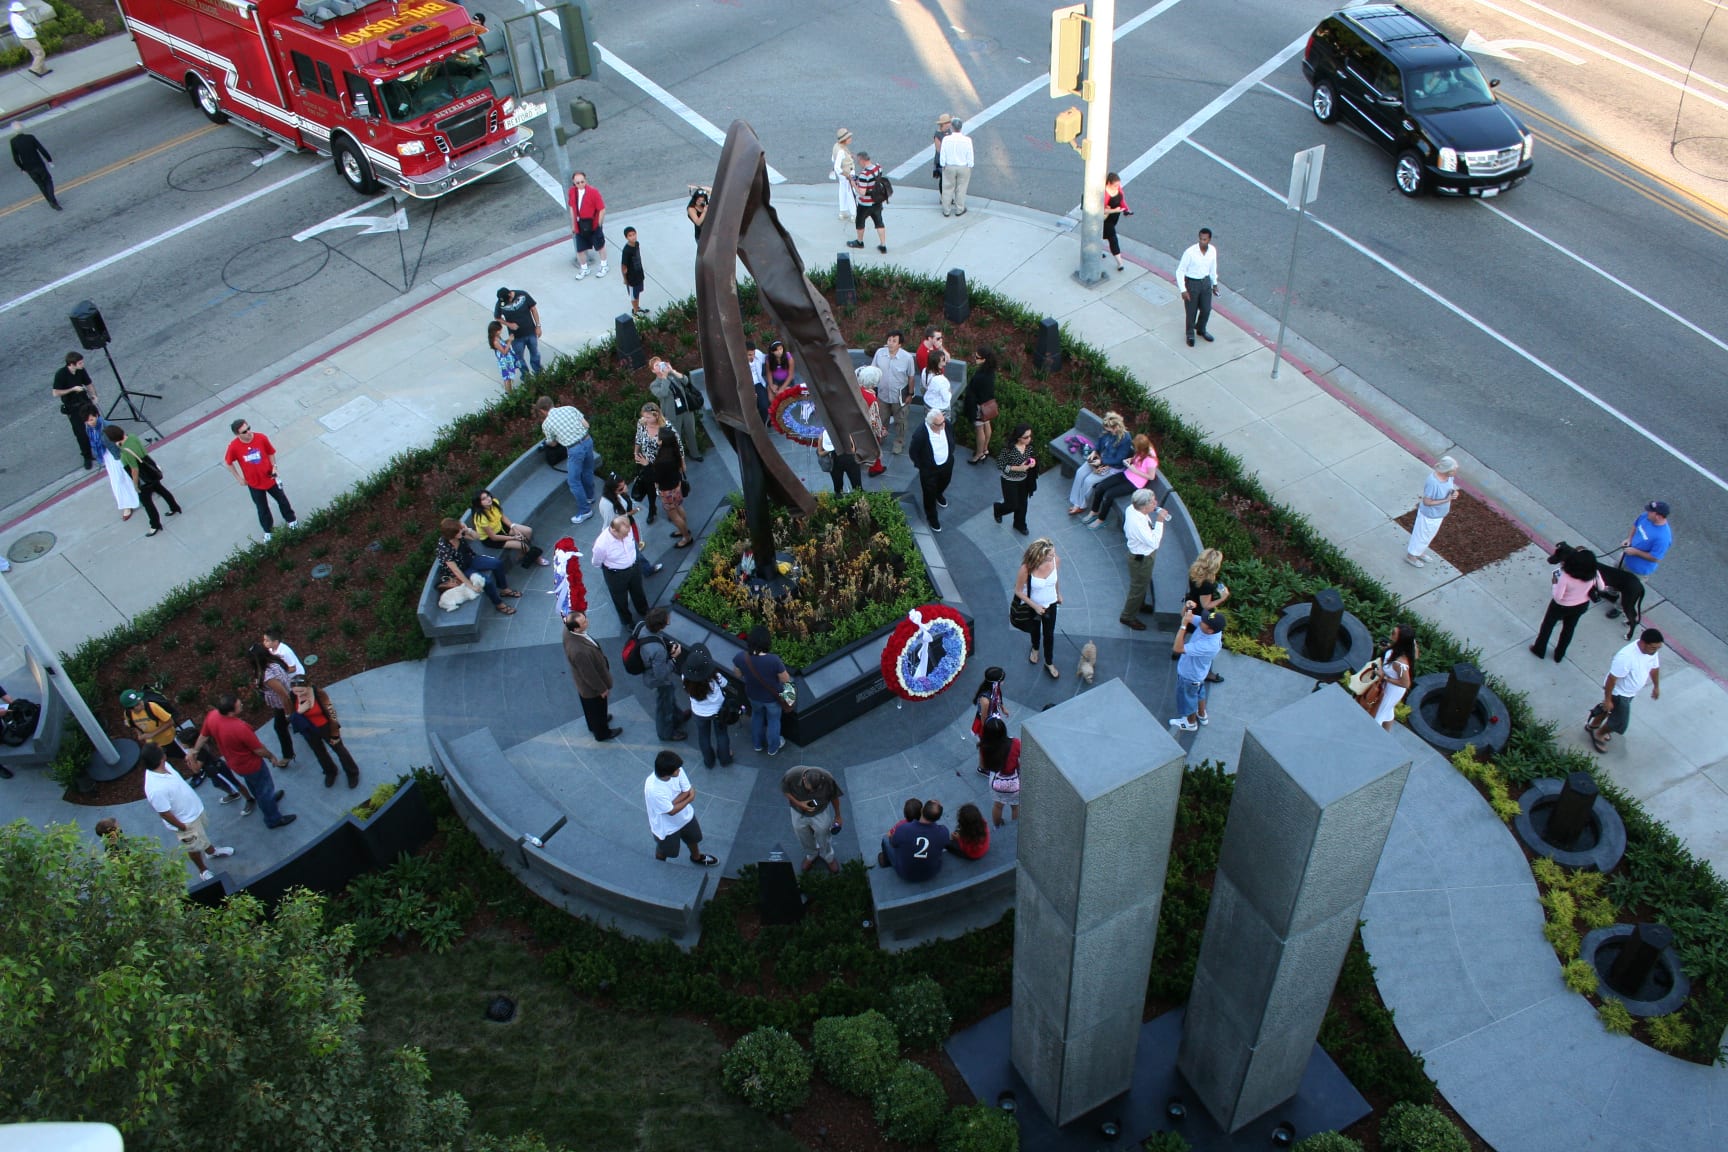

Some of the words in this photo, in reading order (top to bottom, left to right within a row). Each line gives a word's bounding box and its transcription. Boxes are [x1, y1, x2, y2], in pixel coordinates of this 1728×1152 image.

[339, 2, 446, 44] BHL-USAR
[433, 101, 466, 119] BEVERLY
[466, 92, 488, 106] HILLS
[914, 836, 930, 859] 2
